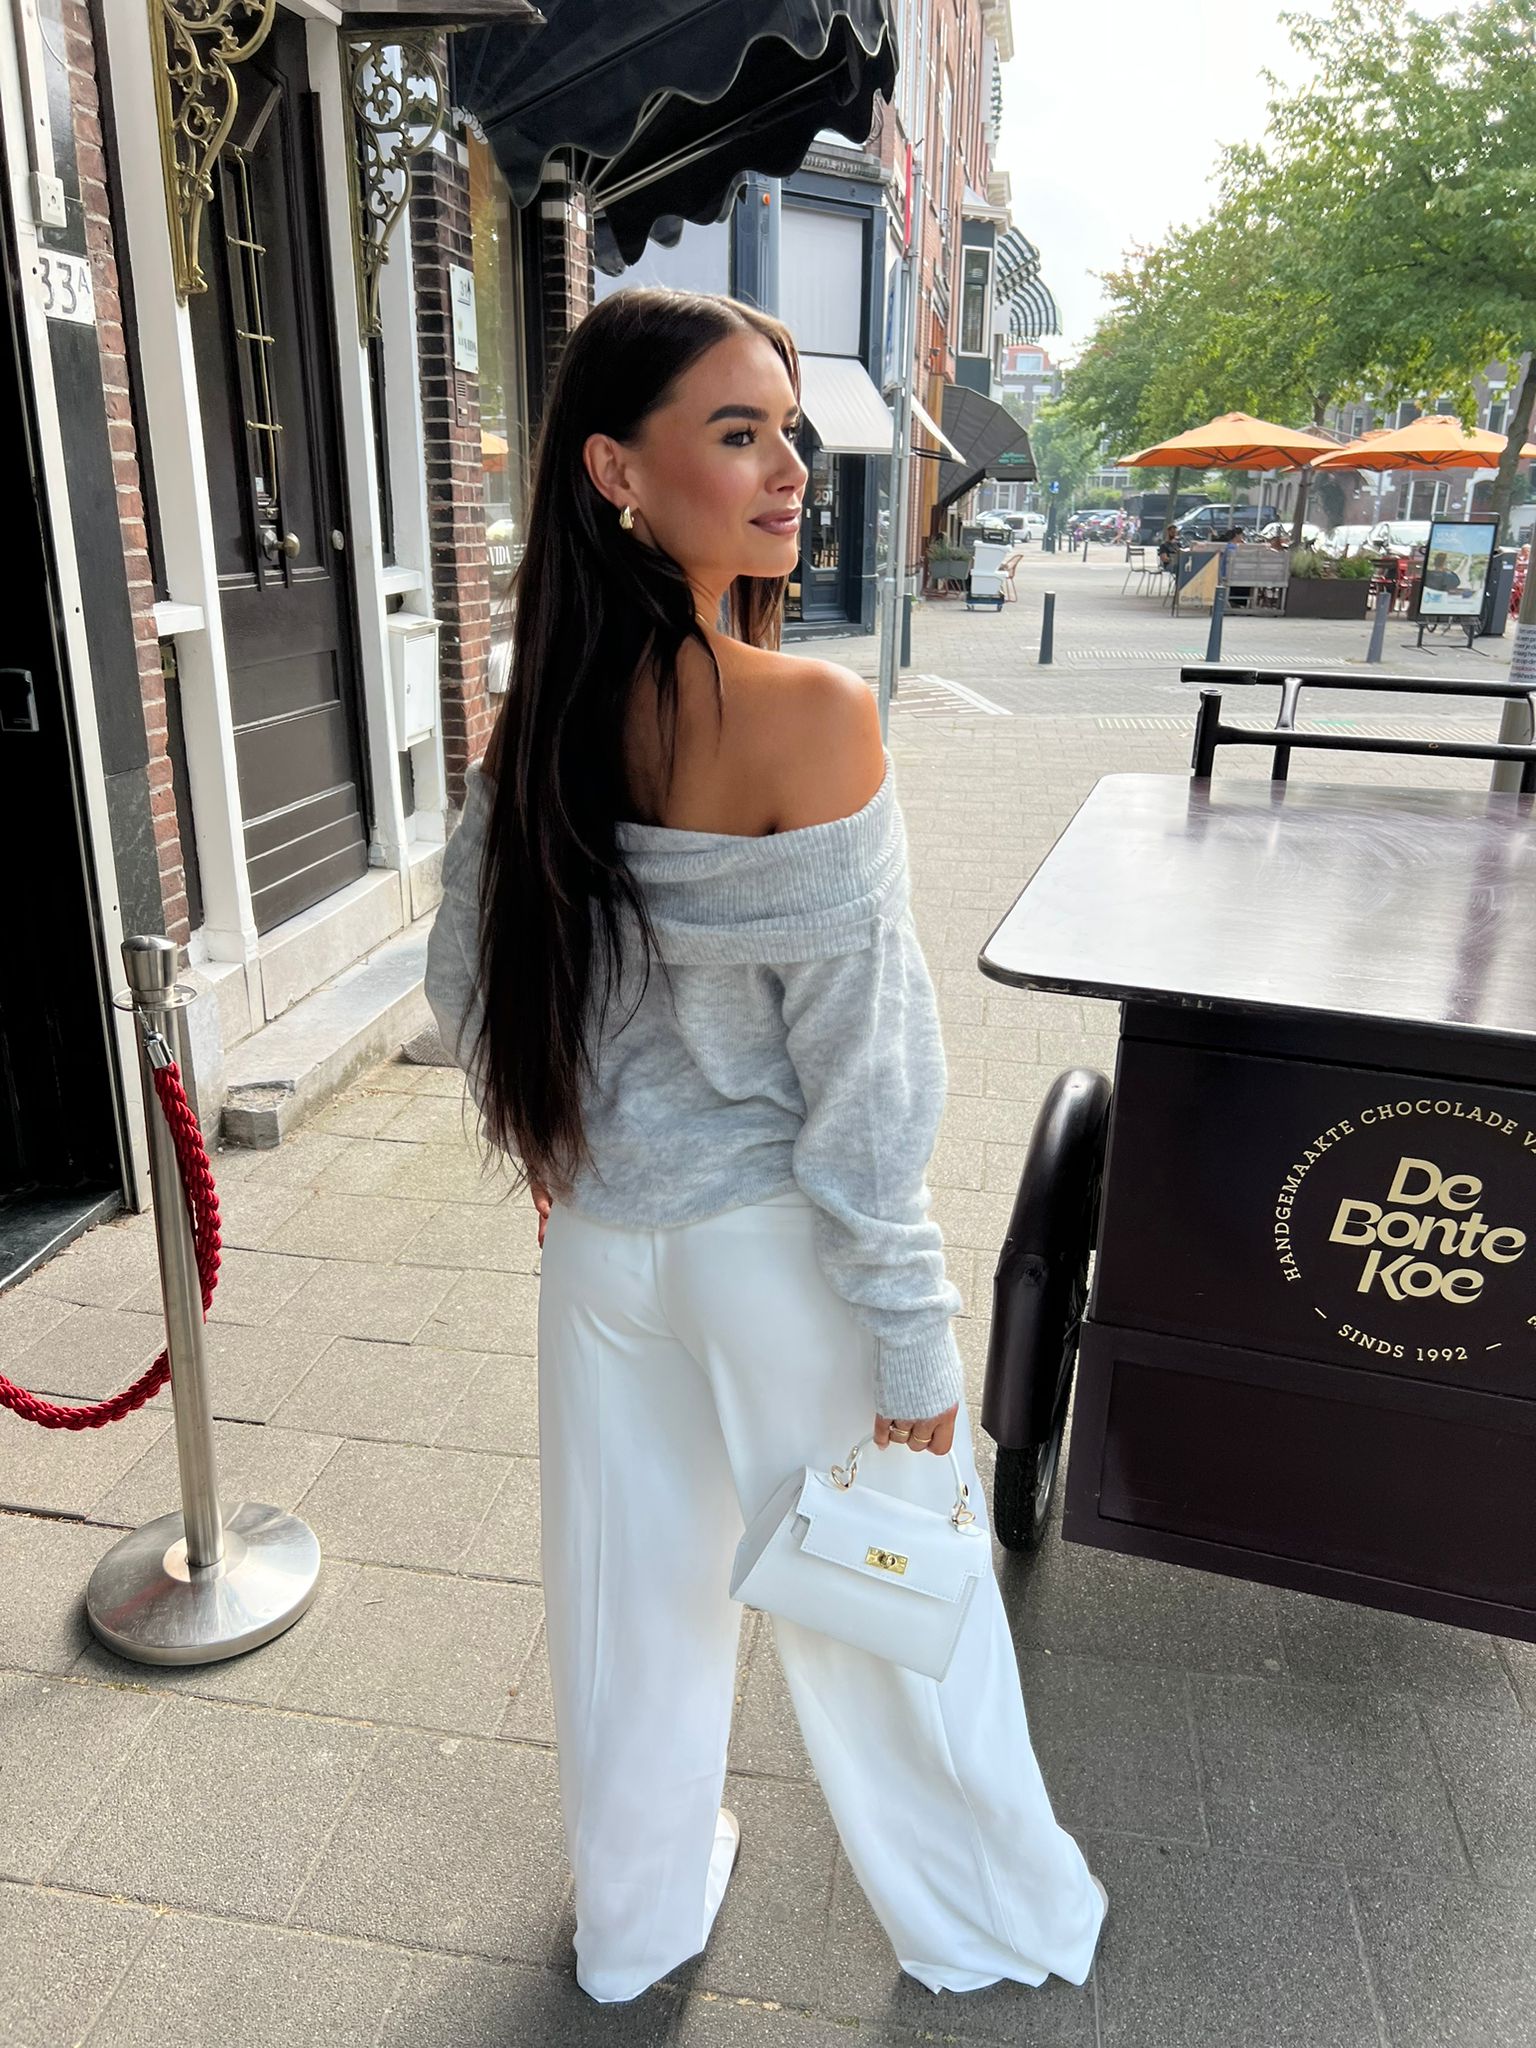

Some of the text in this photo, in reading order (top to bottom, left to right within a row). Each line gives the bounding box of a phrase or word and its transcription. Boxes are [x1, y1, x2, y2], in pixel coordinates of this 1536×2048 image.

[488, 545, 511, 566] VIDA
[1275, 1119, 1354, 1282] HANDGEMAAKTE
[1360, 1099, 1518, 1135] CHOCOLADE
[1386, 1156, 1483, 1212] De
[1328, 1198, 1527, 1264] Bonte
[1357, 1249, 1485, 1304] Koe
[1337, 1324, 1468, 1362] SINDS 1992
